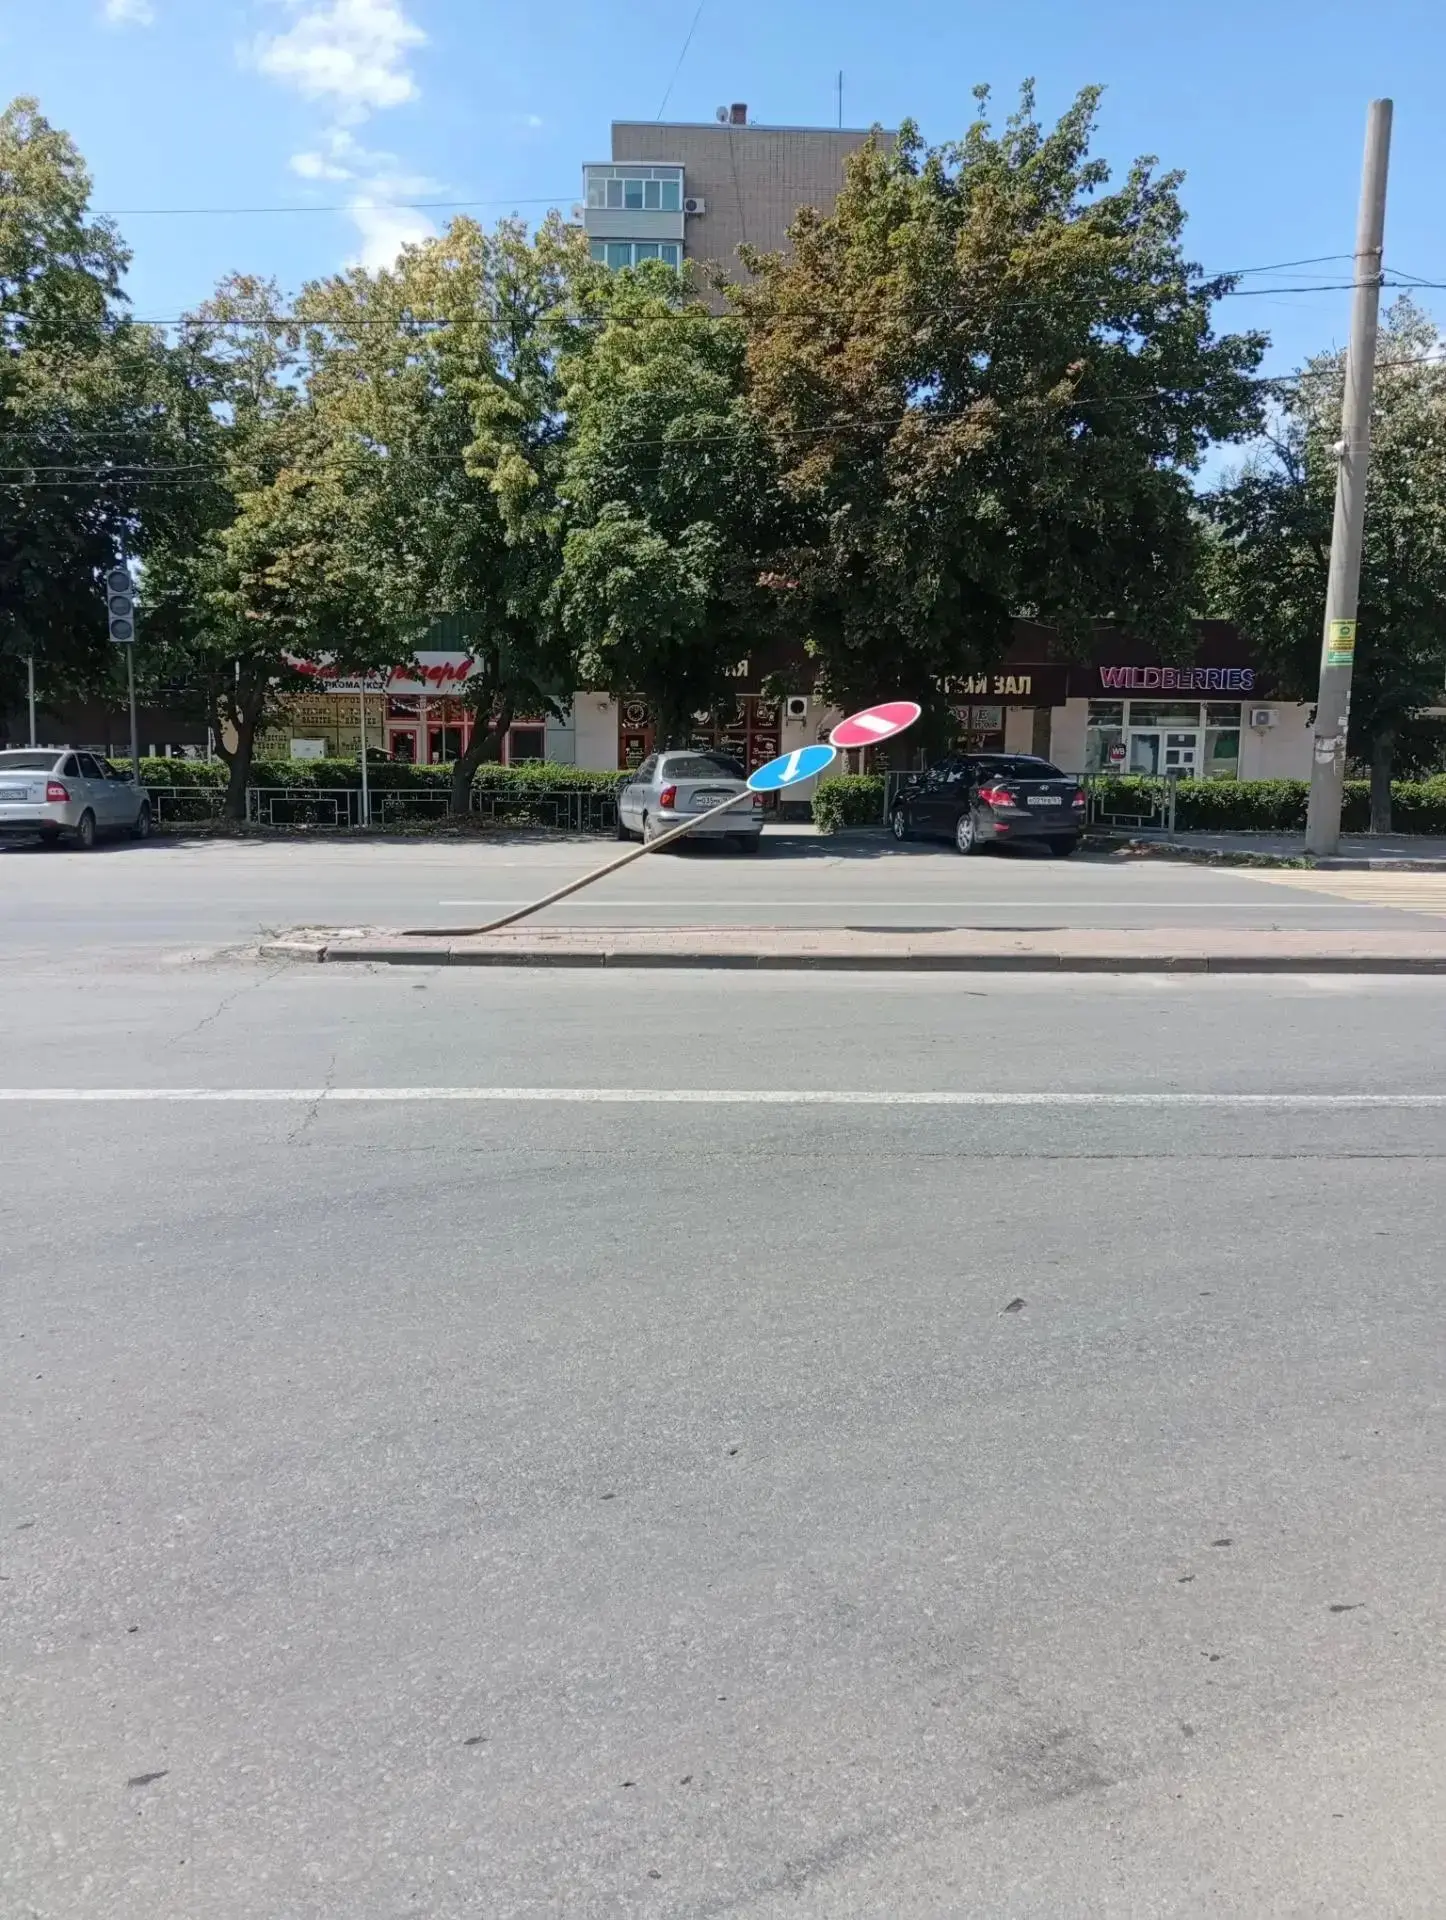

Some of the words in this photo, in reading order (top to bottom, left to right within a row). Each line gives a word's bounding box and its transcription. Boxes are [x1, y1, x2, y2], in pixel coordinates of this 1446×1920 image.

[993, 674, 1032, 695] ЗАЛ
[1100, 666, 1255, 691] WILDBERRIES
[1112, 747, 1126, 756] WB
